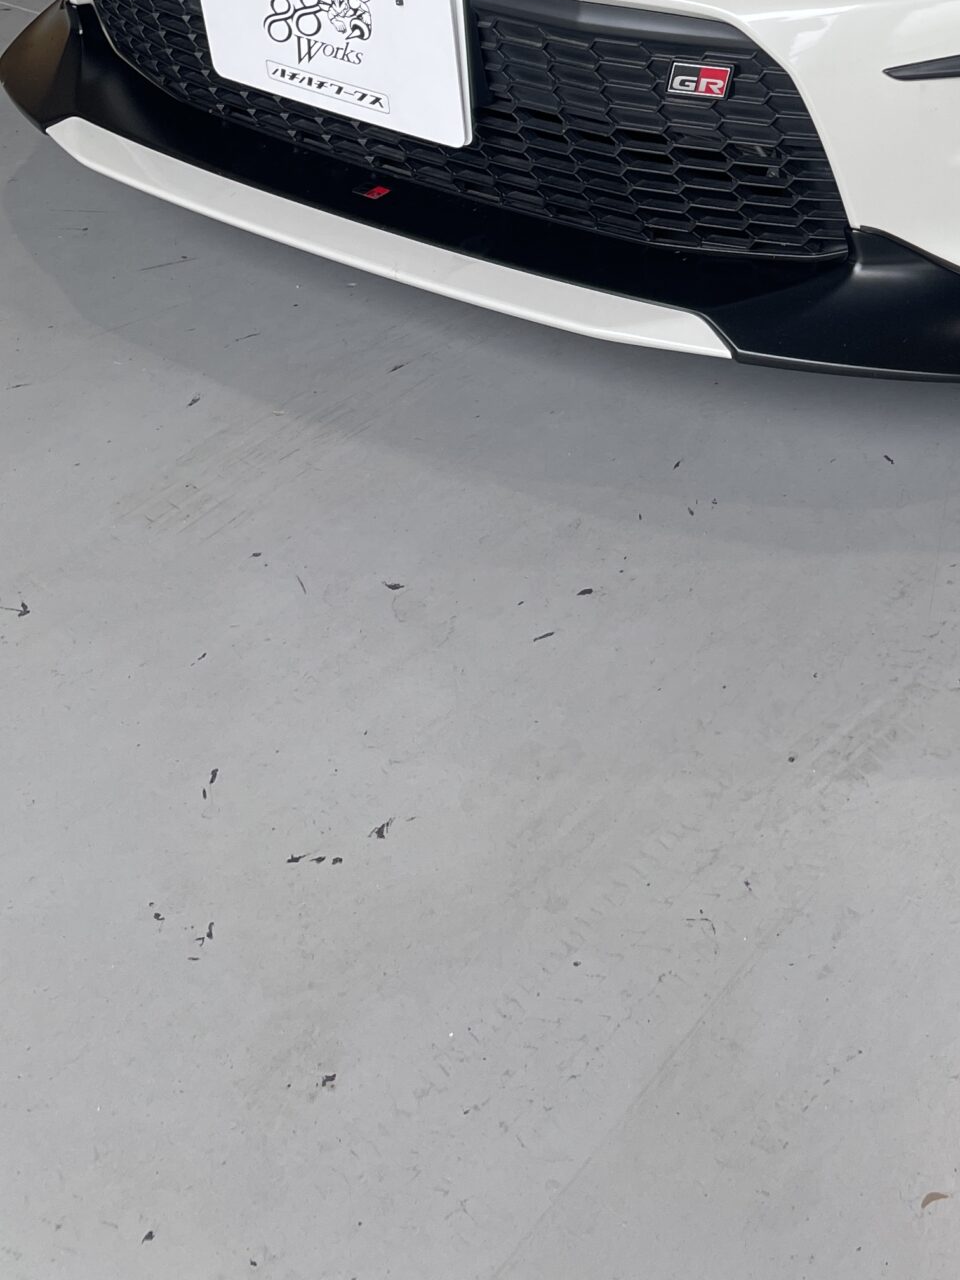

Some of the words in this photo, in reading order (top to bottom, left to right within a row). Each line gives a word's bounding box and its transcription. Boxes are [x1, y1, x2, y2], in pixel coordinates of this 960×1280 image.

[294, 34, 364, 65] Works
[271, 68, 385, 109] ハチハチワークス
[672, 75, 724, 94] GR
